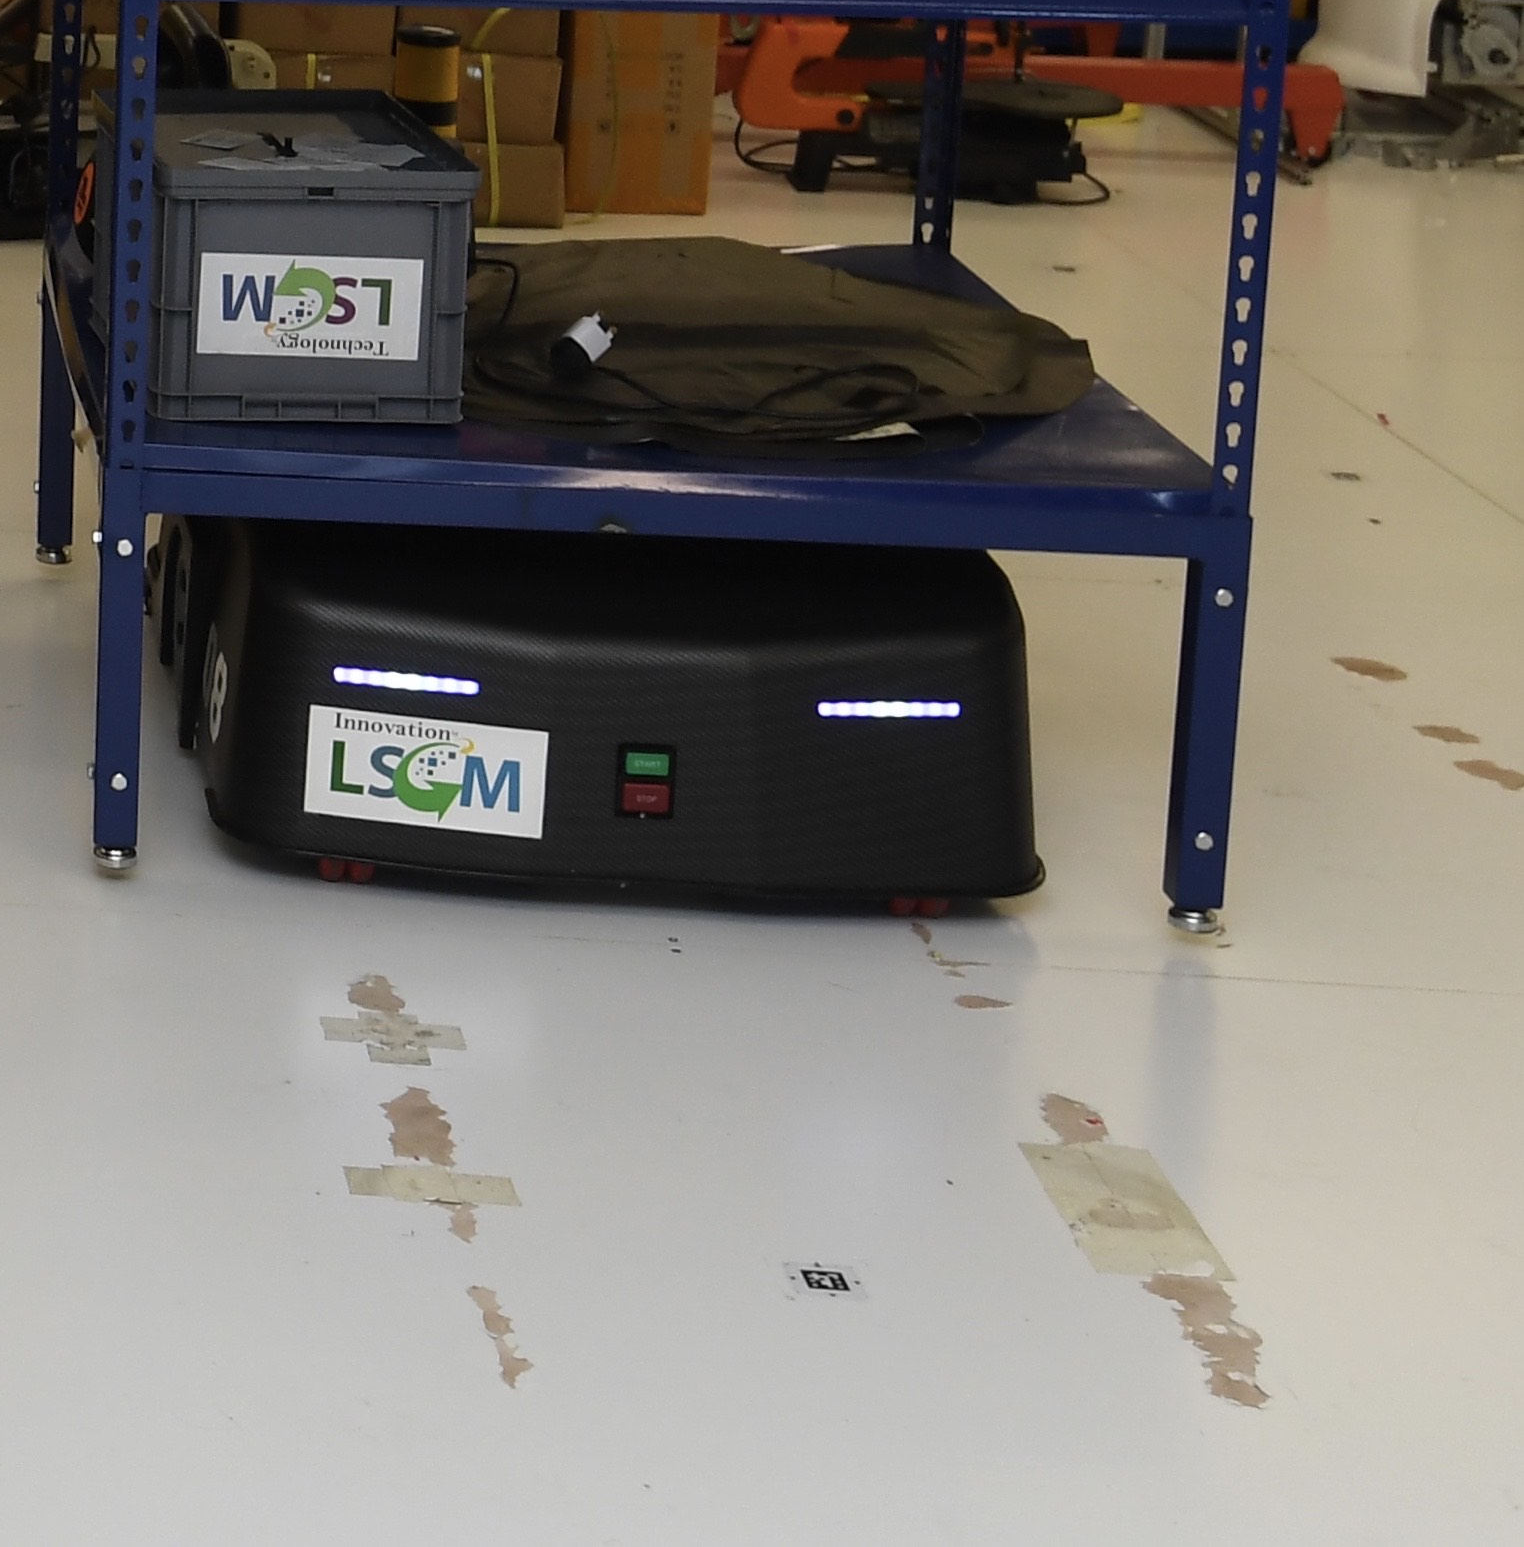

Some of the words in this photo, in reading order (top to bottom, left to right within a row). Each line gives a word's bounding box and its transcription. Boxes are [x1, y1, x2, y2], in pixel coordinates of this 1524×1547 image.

[222, 259, 393, 332] LSCM
[277, 333, 390, 356] Technology
[333, 712, 452, 741] Innovation
[329, 738, 521, 823] LSCM
